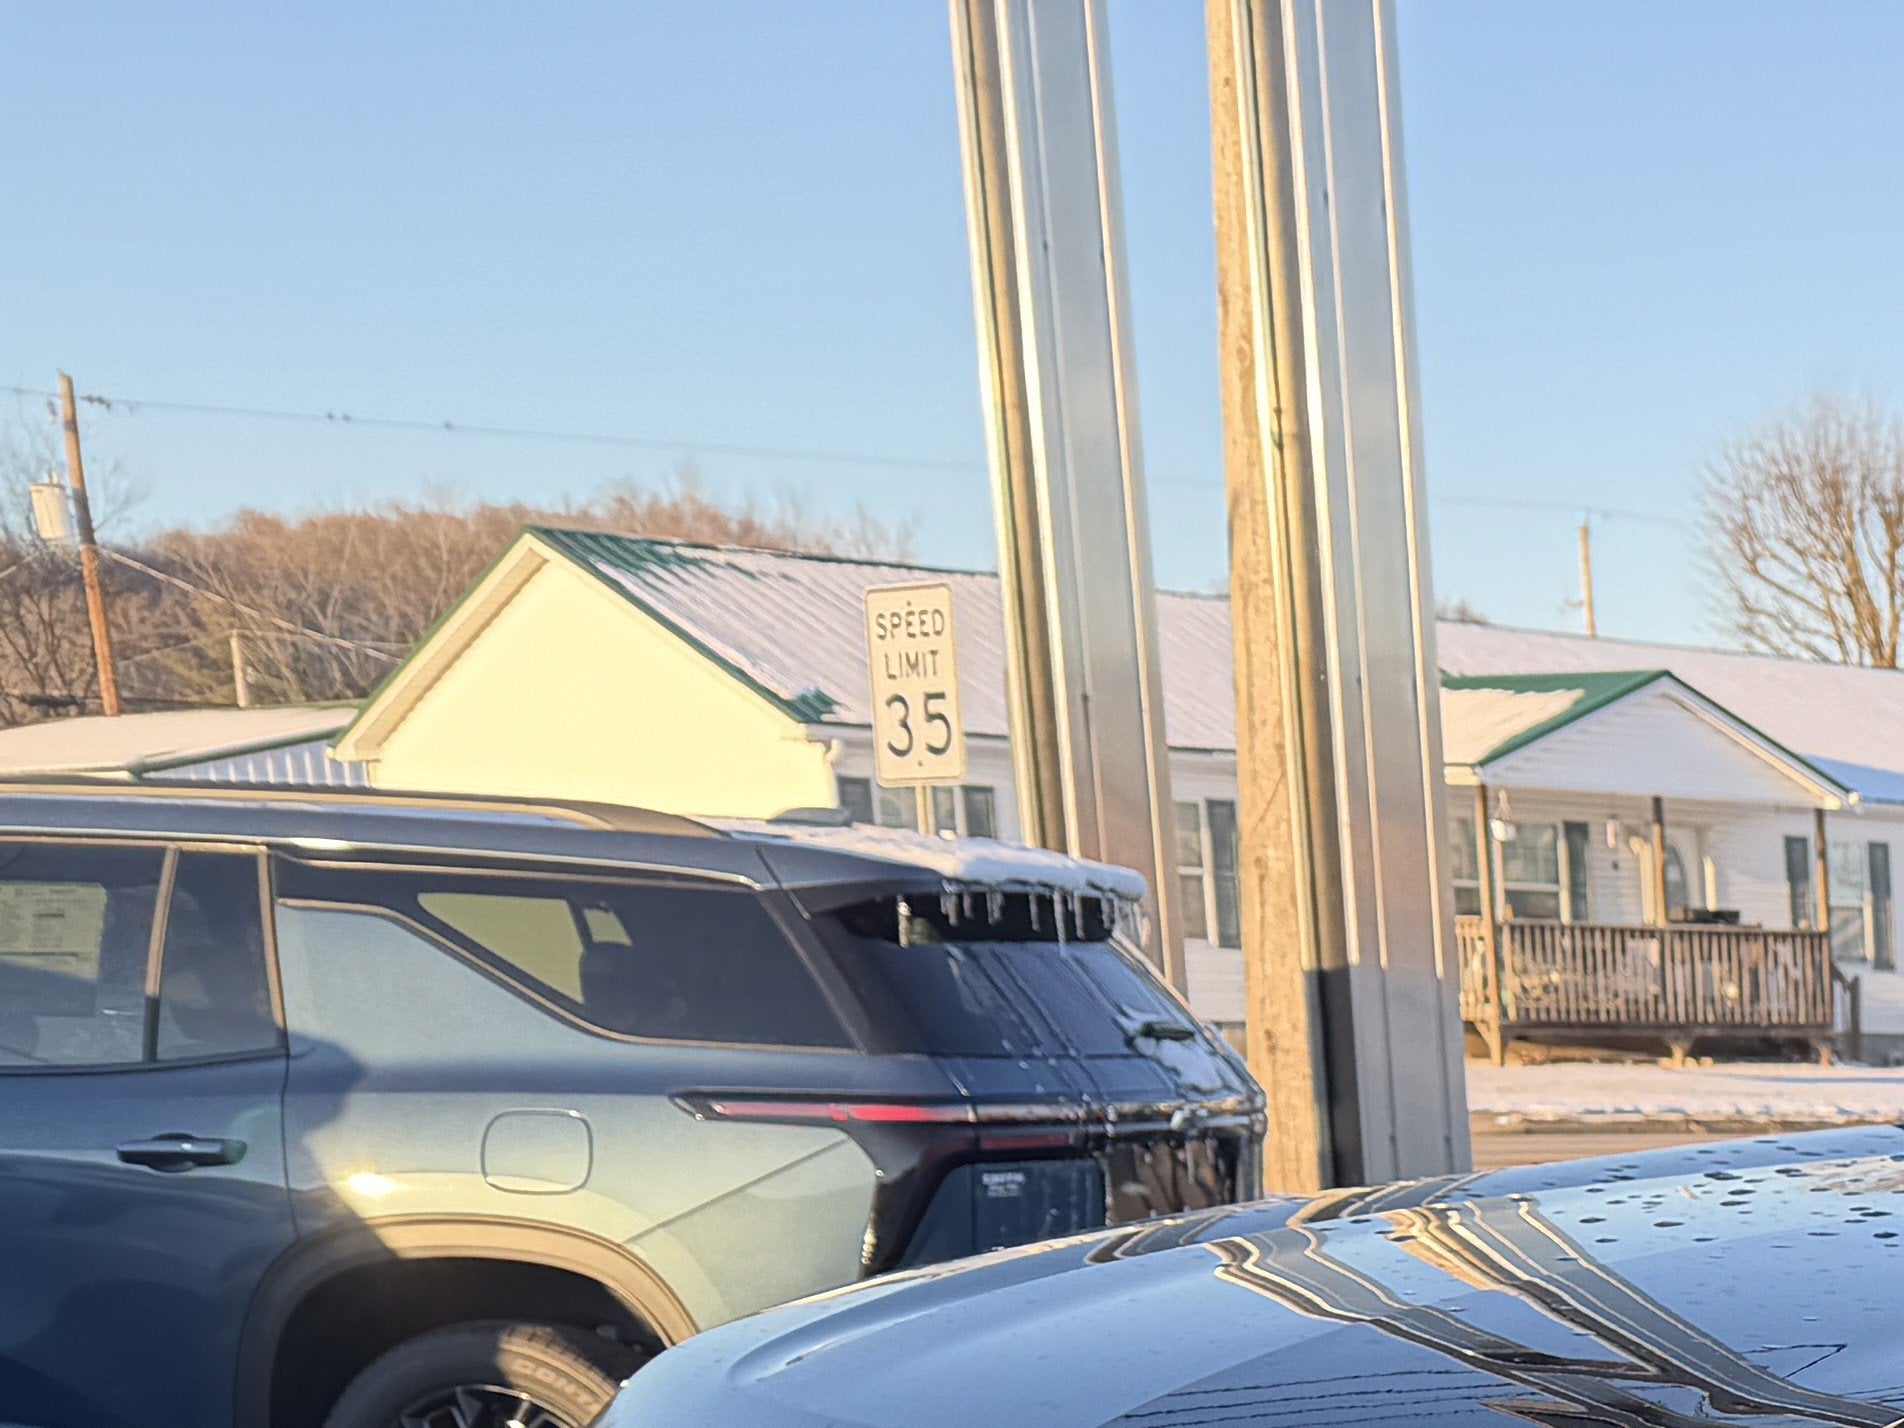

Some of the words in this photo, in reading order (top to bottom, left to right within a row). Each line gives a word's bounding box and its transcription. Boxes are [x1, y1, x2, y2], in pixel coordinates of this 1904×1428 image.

[875, 608, 945, 641] SPEED
[884, 649, 939, 680] LIMIT
[885, 690, 952, 758] 35
